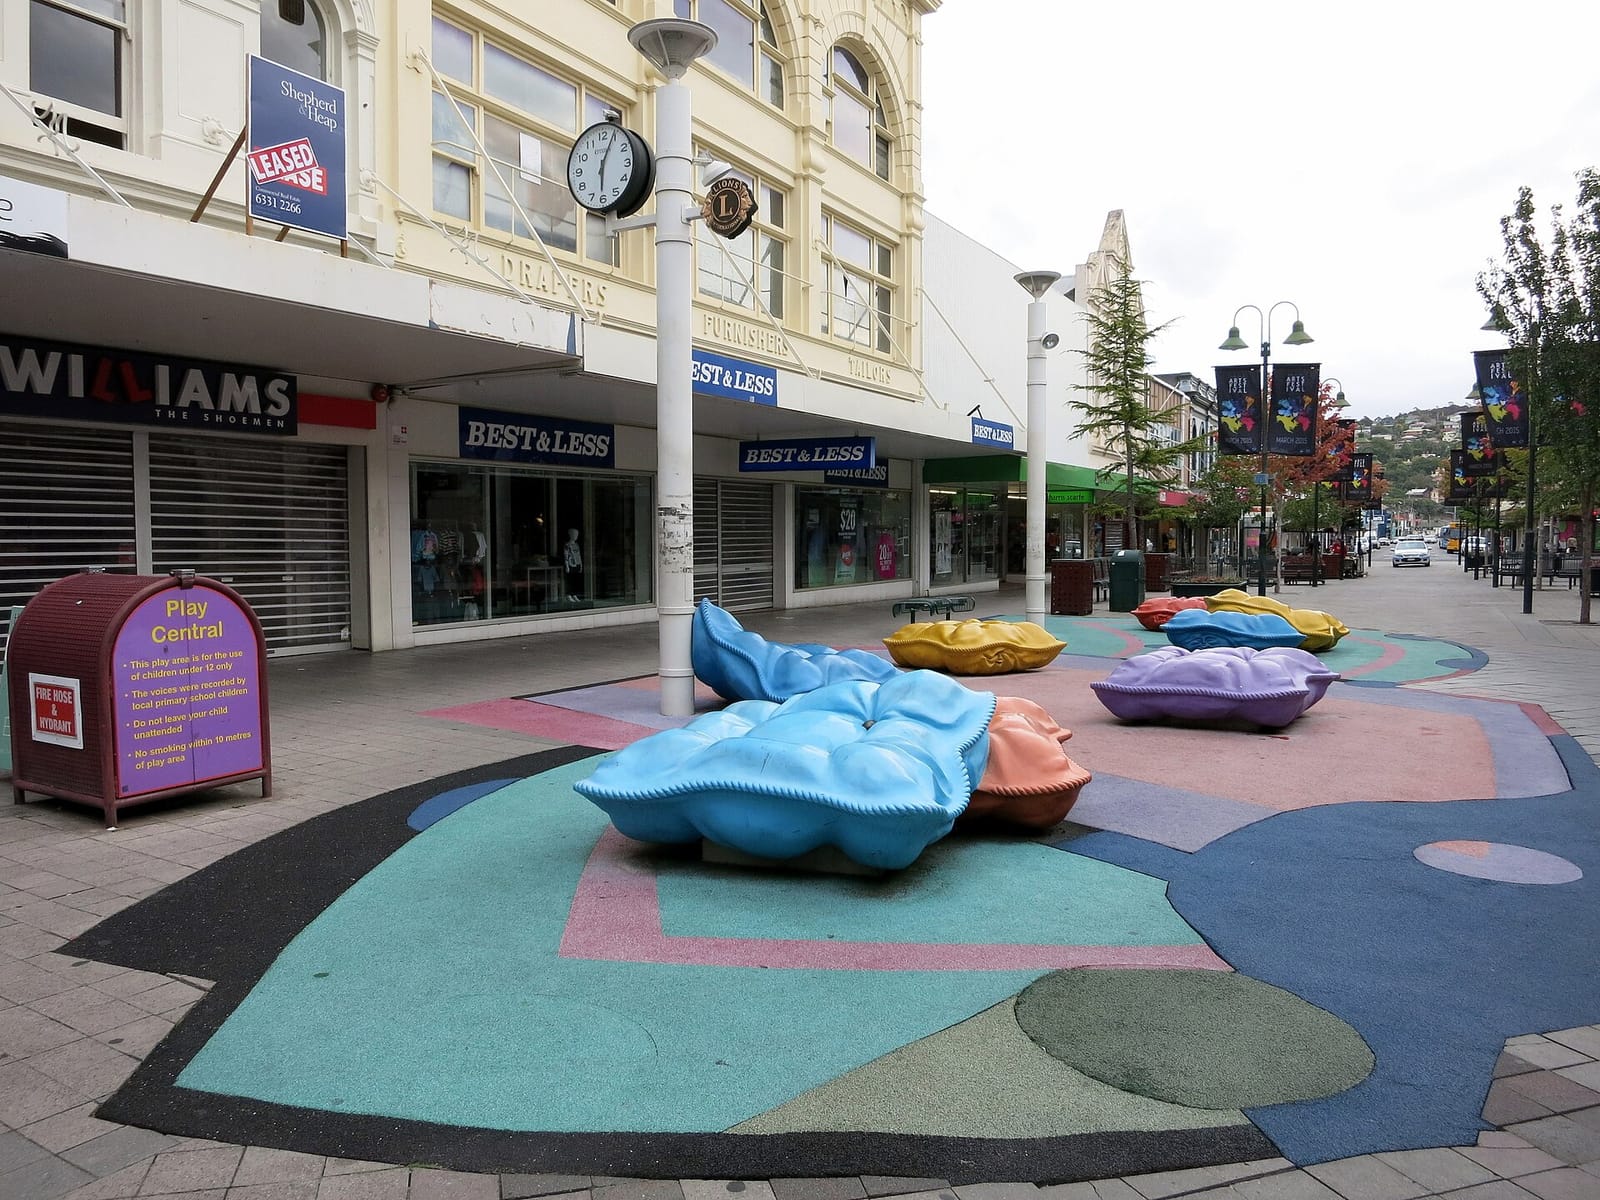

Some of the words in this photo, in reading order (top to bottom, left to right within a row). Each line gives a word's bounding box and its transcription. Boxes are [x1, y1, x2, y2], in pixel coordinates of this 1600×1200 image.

[281, 80, 336, 114] Shepherd
[586, 140, 594, 149] 11
[598, 132, 608, 141] 12
[620, 144, 628, 152] 2
[250, 144, 314, 180] LEASED
[578, 154, 588, 162] 10
[624, 158, 631, 168] 3
[576, 168, 583, 177] 9
[579, 182, 586, 190] 8
[612, 188, 620, 197] 5
[713, 180, 740, 192] LIONS
[256, 194, 276, 208] 6331
[280, 200, 301, 214] 2266
[588, 193, 595, 202] 7
[600, 194, 607, 203] 6
[719, 194, 733, 217] L
[502, 254, 608, 307] DRAPERS
[703, 314, 788, 356] FURNISHERS
[848, 356, 891, 384] TAILORS
[0, 346, 290, 416] WILLIAMS
[156, 410, 188, 420] THE
[204, 413, 284, 428] SHOEMEN
[840, 508, 856, 530] $20
[166, 600, 208, 619] Play
[152, 620, 223, 643] Central
[130, 661, 150, 669] This
[152, 659, 169, 668] play
[172, 657, 190, 665] area
[202, 652, 212, 661] for
[214, 651, 227, 659] the
[131, 671, 140, 680] of
[142, 668, 177, 680] children
[179, 665, 204, 675] under
[216, 662, 233, 671] only
[36, 687, 52, 700] FIRE
[54, 690, 72, 704] HOSE
[132, 690, 148, 698] The
[151, 685, 177, 696] voices
[179, 684, 199, 692] were
[201, 678, 235, 689] recorded
[237, 677, 246, 687] by
[132, 700, 153, 710] local
[156, 697, 187, 709] primary
[190, 692, 216, 702] school
[218, 687, 248, 697] children
[52, 704, 57, 716] &
[133, 720, 146, 728] Do
[149, 717, 162, 726] not
[165, 713, 186, 723] leave
[189, 710, 207, 721] your
[209, 706, 228, 715] child
[40, 717, 71, 733] HYDRANT
[134, 725, 182, 740] unattended
[135, 750, 147, 758] No
[150, 743, 186, 756] smoking
[188, 736, 213, 748] within
[226, 731, 251, 742] metres
[135, 761, 144, 770] of
[147, 758, 165, 769] play
[167, 755, 185, 764] area
